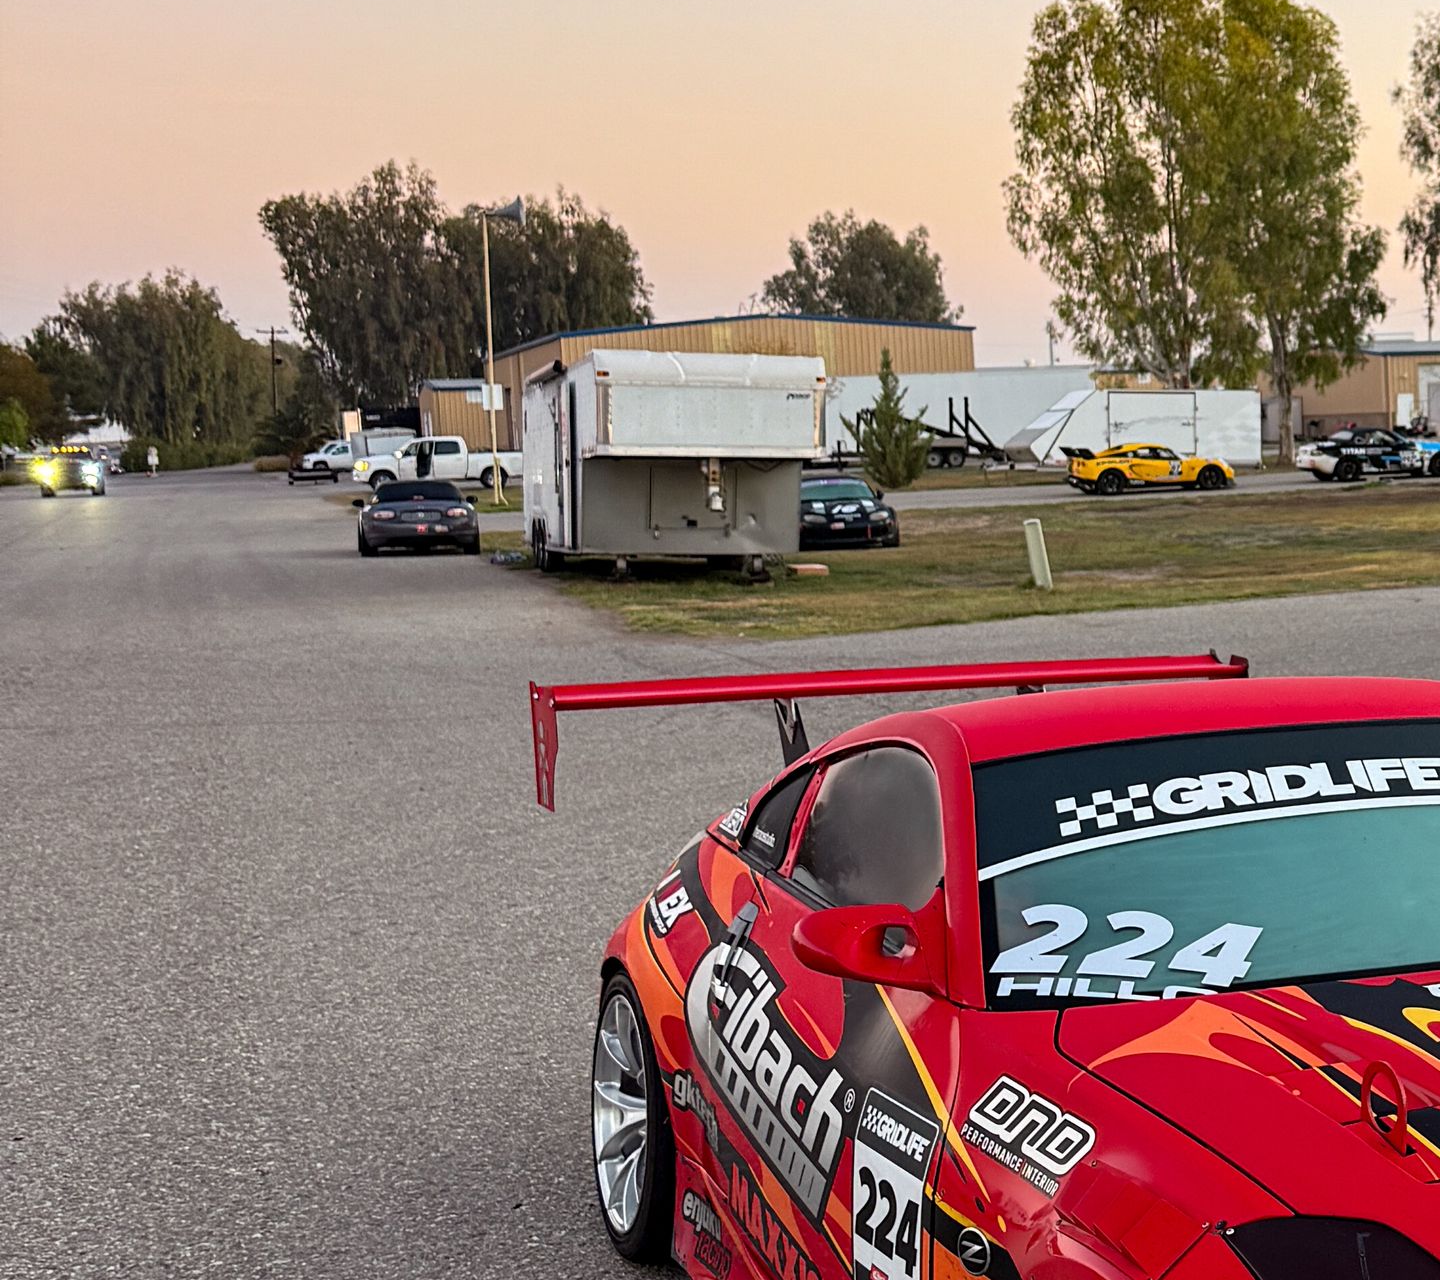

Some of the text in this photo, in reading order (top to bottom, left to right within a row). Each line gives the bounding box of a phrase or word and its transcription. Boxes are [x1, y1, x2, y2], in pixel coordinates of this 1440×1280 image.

[989, 904, 1264, 987] 224
[995, 977, 1220, 1002] HILL
[686, 941, 844, 1210] Eibach
[877, 1111, 931, 1163] GRIDLIFE
[961, 1122, 1060, 1197] PERFORMANCE INTERIOR
[855, 1166, 920, 1278] 224
